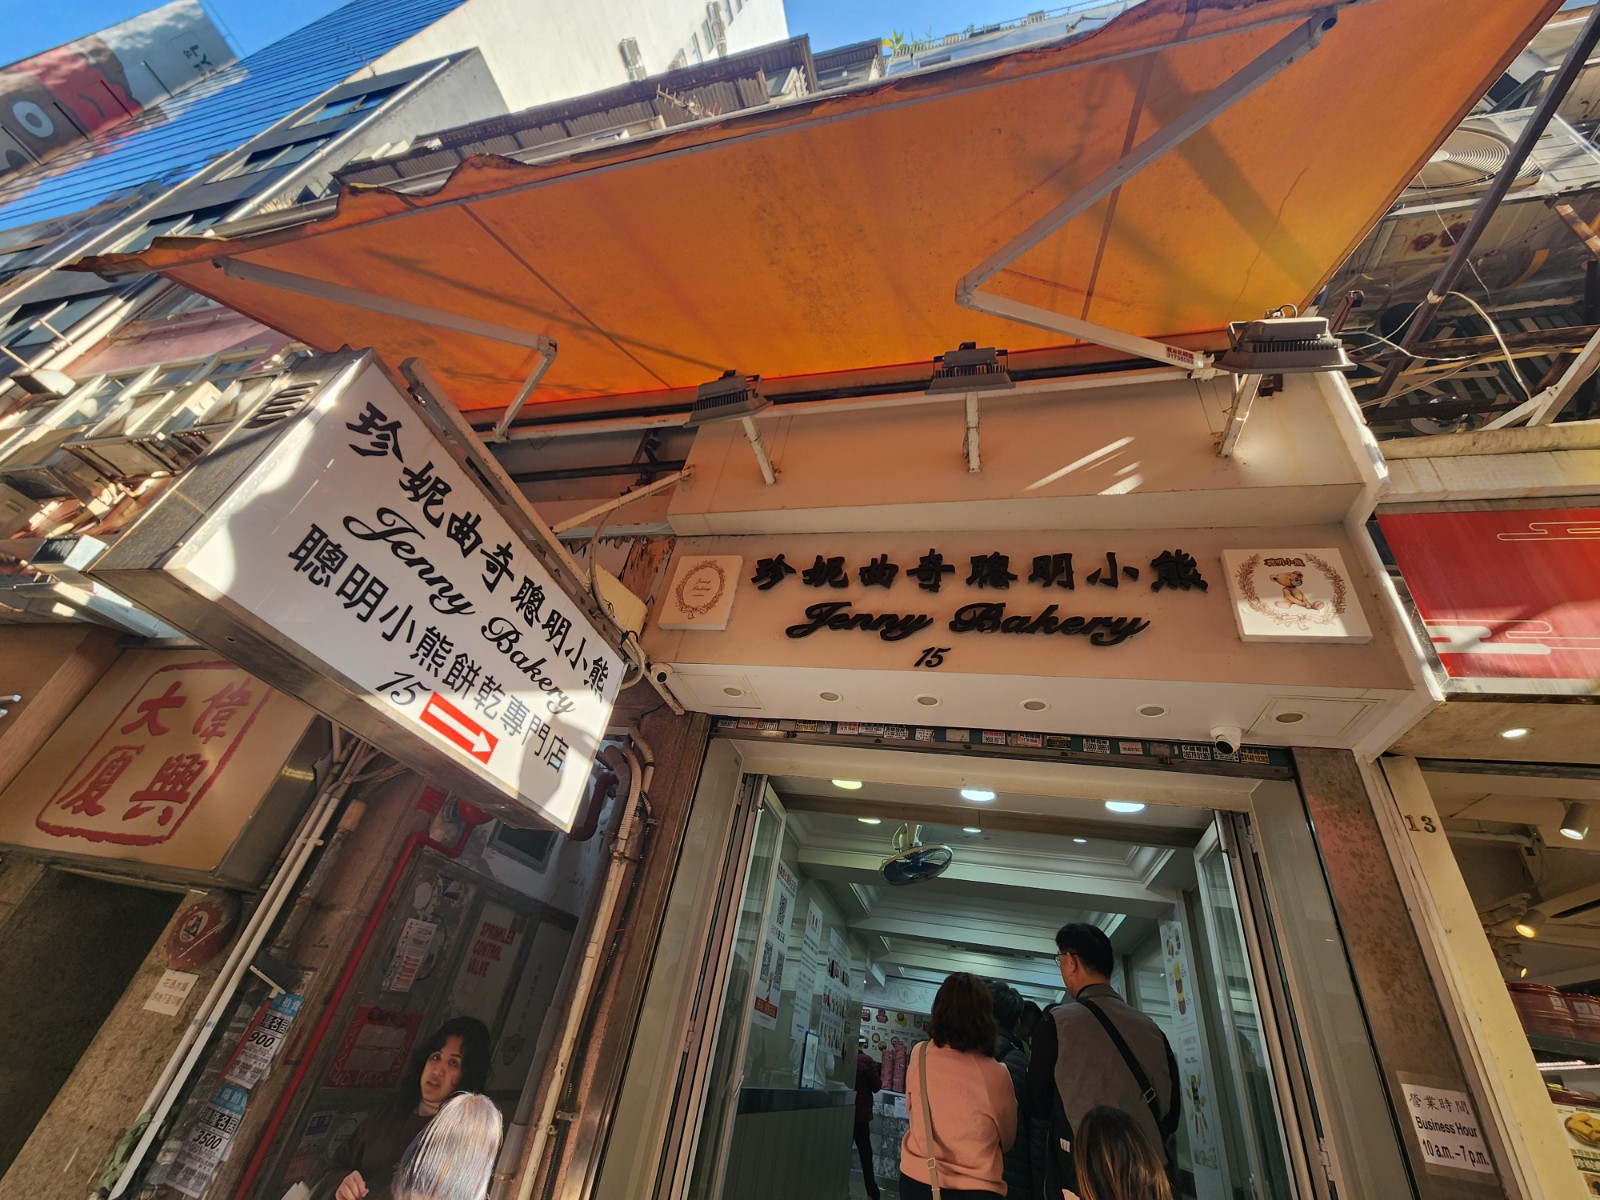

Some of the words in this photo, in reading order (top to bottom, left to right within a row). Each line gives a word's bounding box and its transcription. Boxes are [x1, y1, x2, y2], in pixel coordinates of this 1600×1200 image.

[751, 548, 1209, 593] 珍妮曲奇聰明小熊
[342, 506, 476, 616] Jenny
[480, 615, 577, 715] Bakery
[785, 601, 934, 641] Jenny
[949, 602, 1150, 646] Bakery
[288, 523, 570, 774] 聰明小熊餅乾專門店
[914, 646, 951, 668] 15
[375, 670, 431, 706] 15
[1404, 814, 1437, 834] 13
[480, 921, 516, 946] SPRINKLER
[473, 939, 502, 961] CONTROL
[466, 957, 489, 977] VALVE
[1409, 1092, 1470, 1115] 營業時間
[1415, 1116, 1456, 1135] Business
[1455, 1122, 1478, 1138] Hour
[1422, 1138, 1434, 1157] 10
